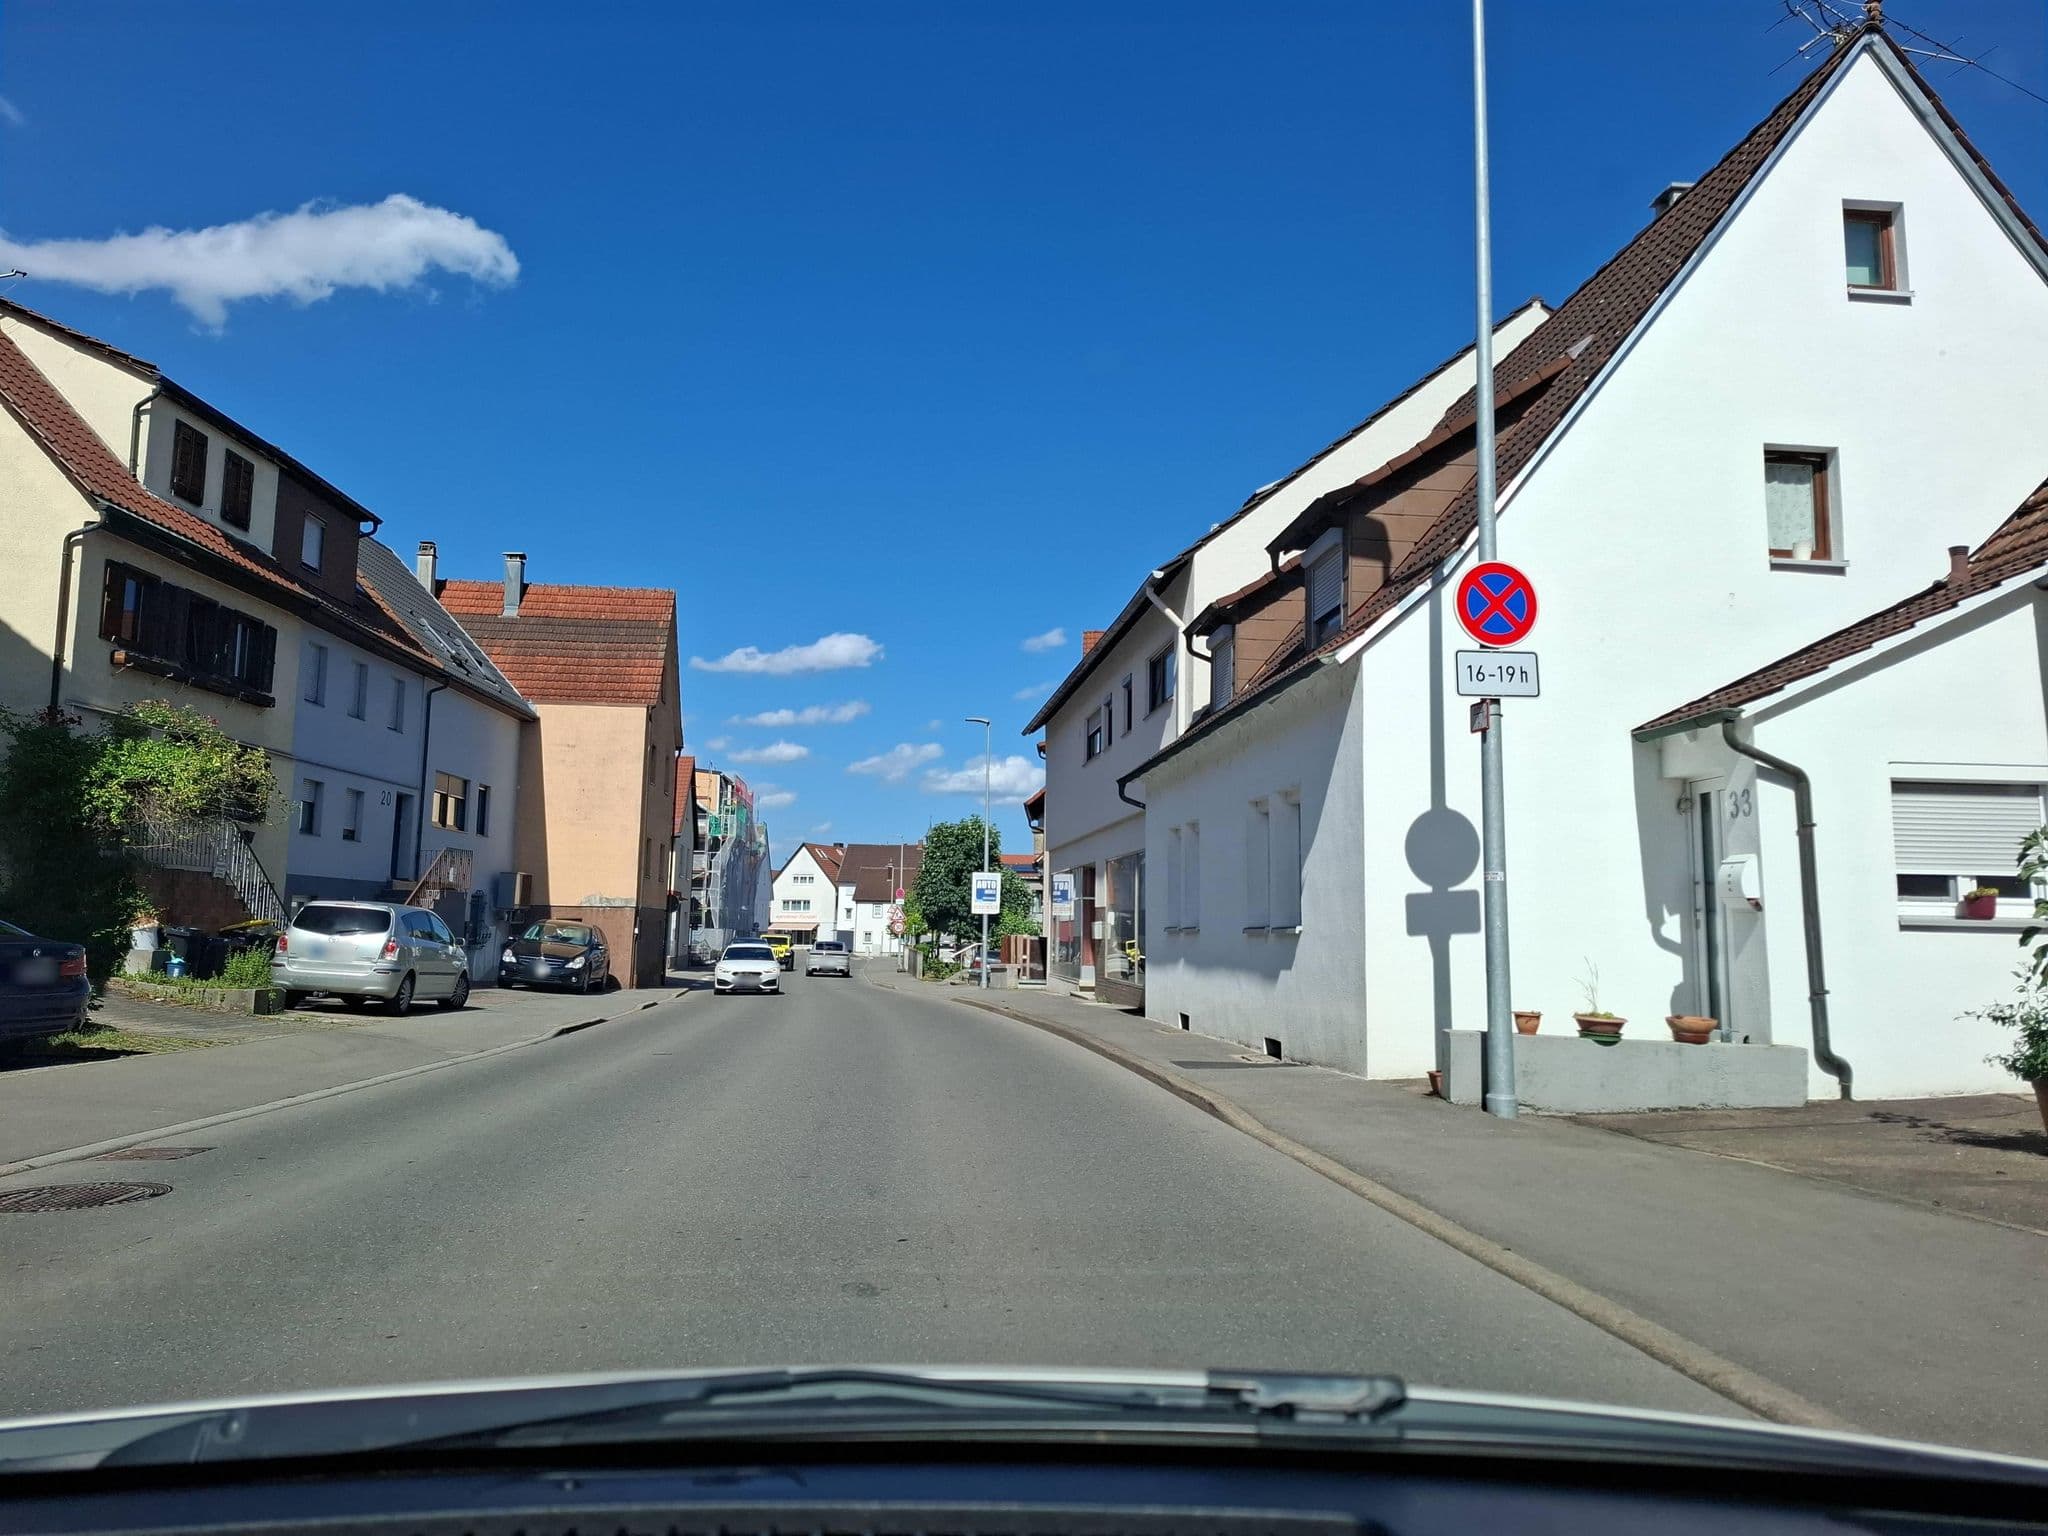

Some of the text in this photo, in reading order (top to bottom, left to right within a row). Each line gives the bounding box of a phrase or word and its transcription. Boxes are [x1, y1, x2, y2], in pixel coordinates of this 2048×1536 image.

[1466, 664, 1528, 683] 16-19 h
[381, 790, 392, 806] 20
[1729, 788, 1752, 819] 33
[977, 880, 997, 889] AUTO
